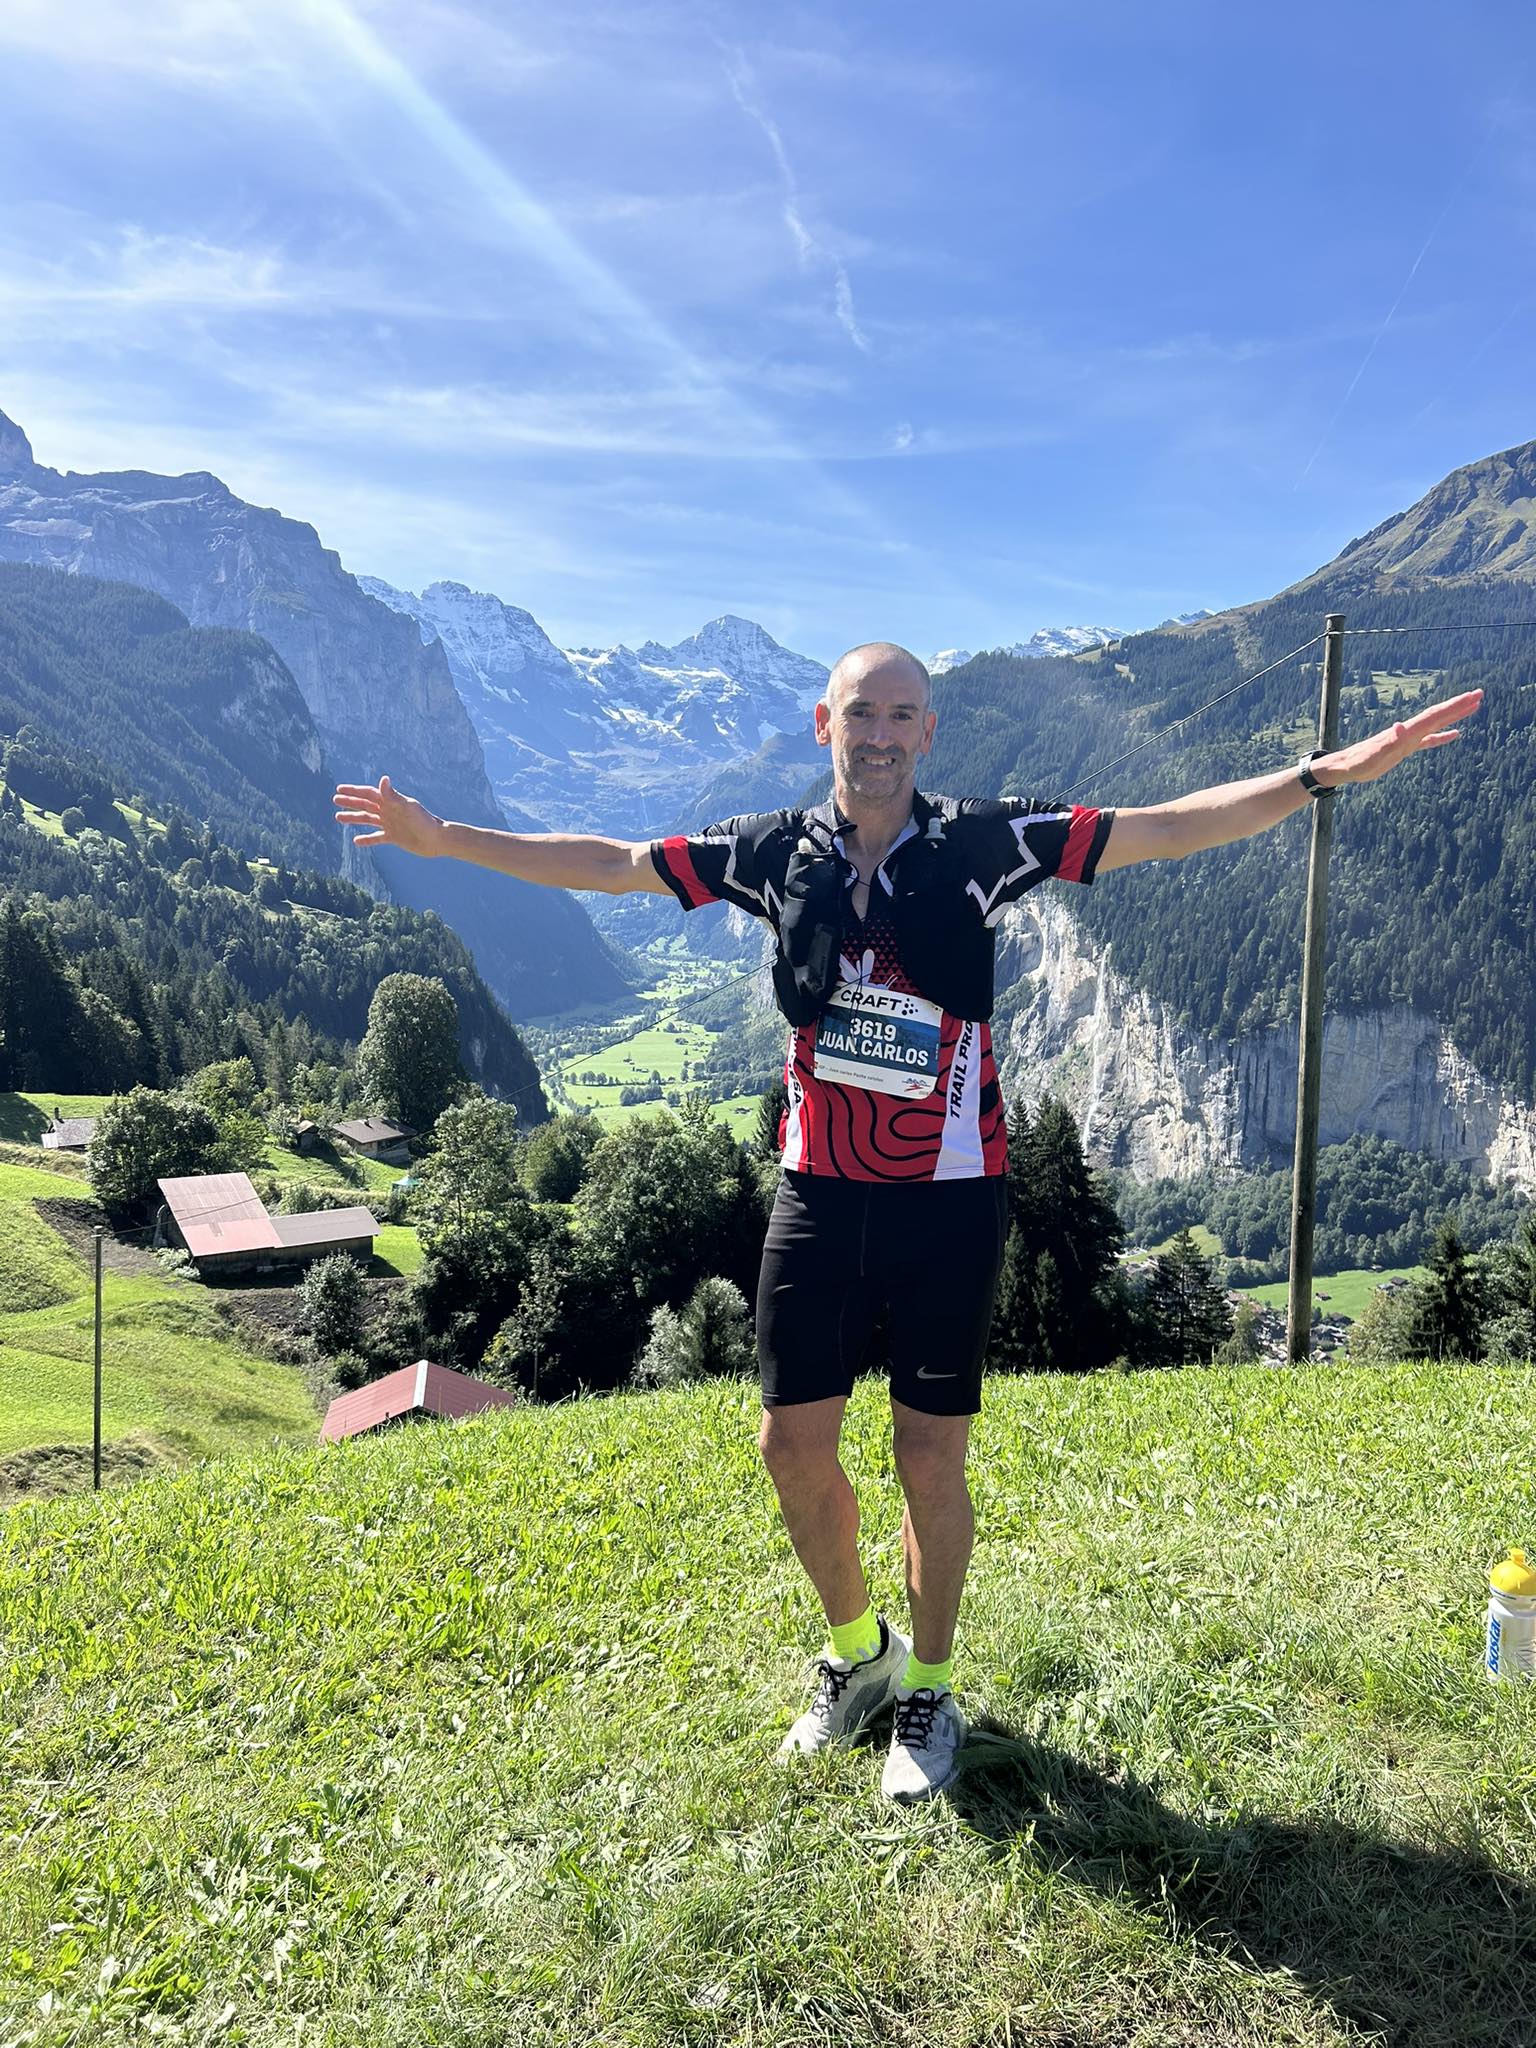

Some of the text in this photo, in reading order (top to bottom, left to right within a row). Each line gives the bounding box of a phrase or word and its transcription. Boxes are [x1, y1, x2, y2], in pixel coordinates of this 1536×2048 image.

[841, 990, 902, 1011] CRAFT
[850, 1017, 897, 1042] 3619
[818, 1030, 857, 1054] JUAN
[861, 1040, 929, 1067] CARLOS
[950, 1064, 967, 1119] TRAIL
